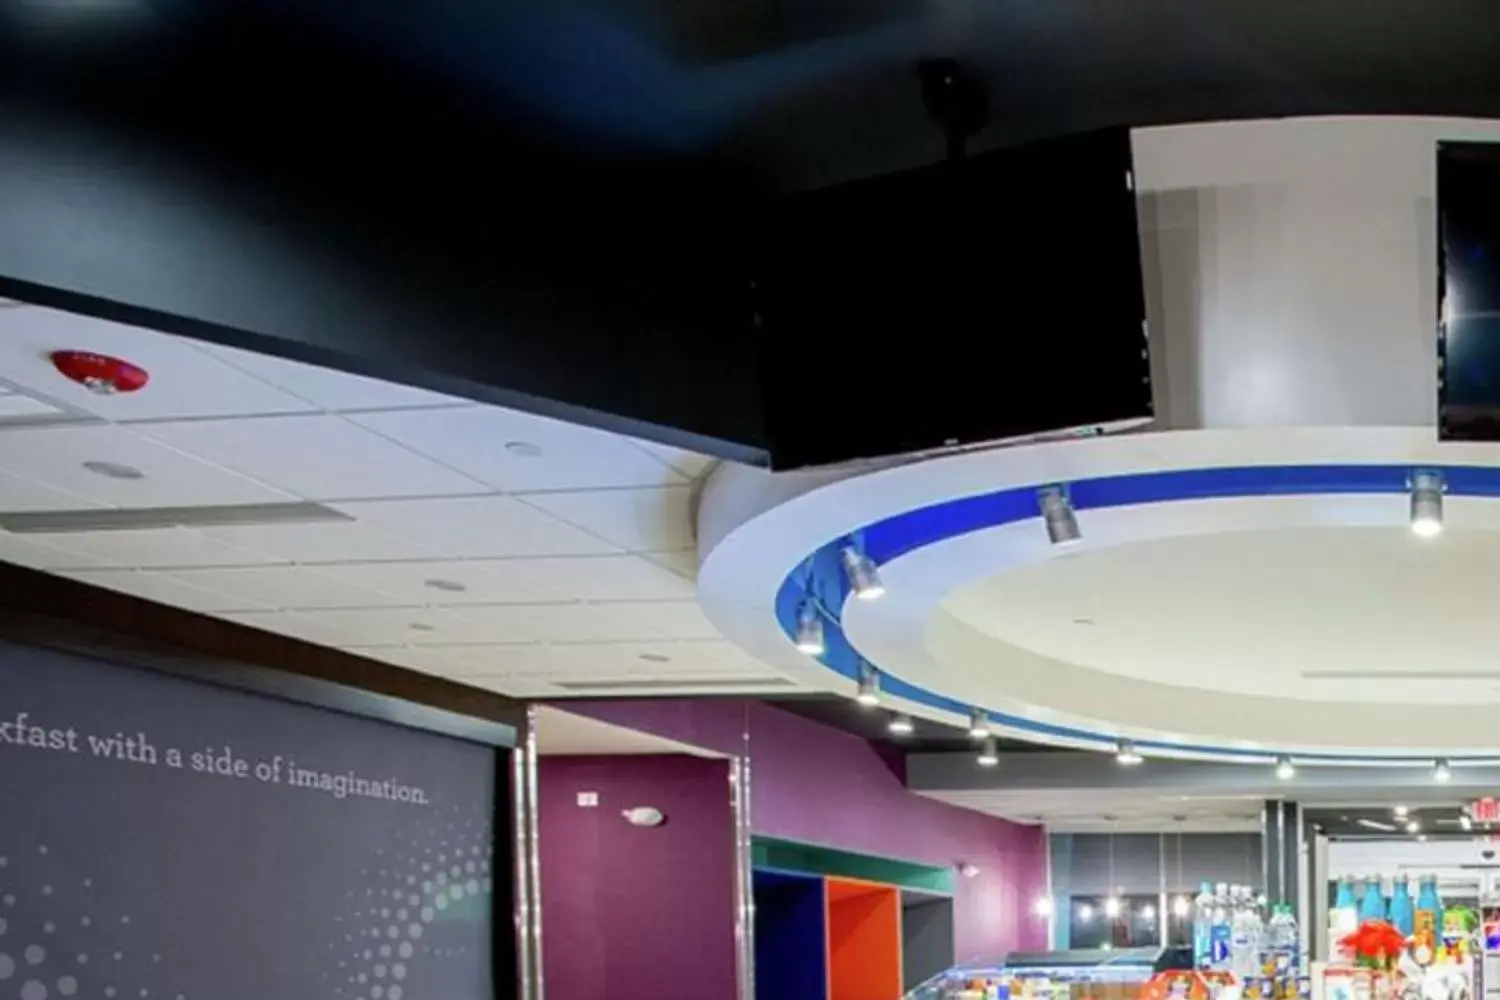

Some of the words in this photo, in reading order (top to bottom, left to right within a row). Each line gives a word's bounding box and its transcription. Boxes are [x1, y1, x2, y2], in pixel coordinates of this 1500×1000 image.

[88, 732, 157, 764] with
[166, 748, 183, 768] a
[191, 746, 249, 778] side
[254, 755, 284, 783] of
[288, 760, 428, 804] imagination.
